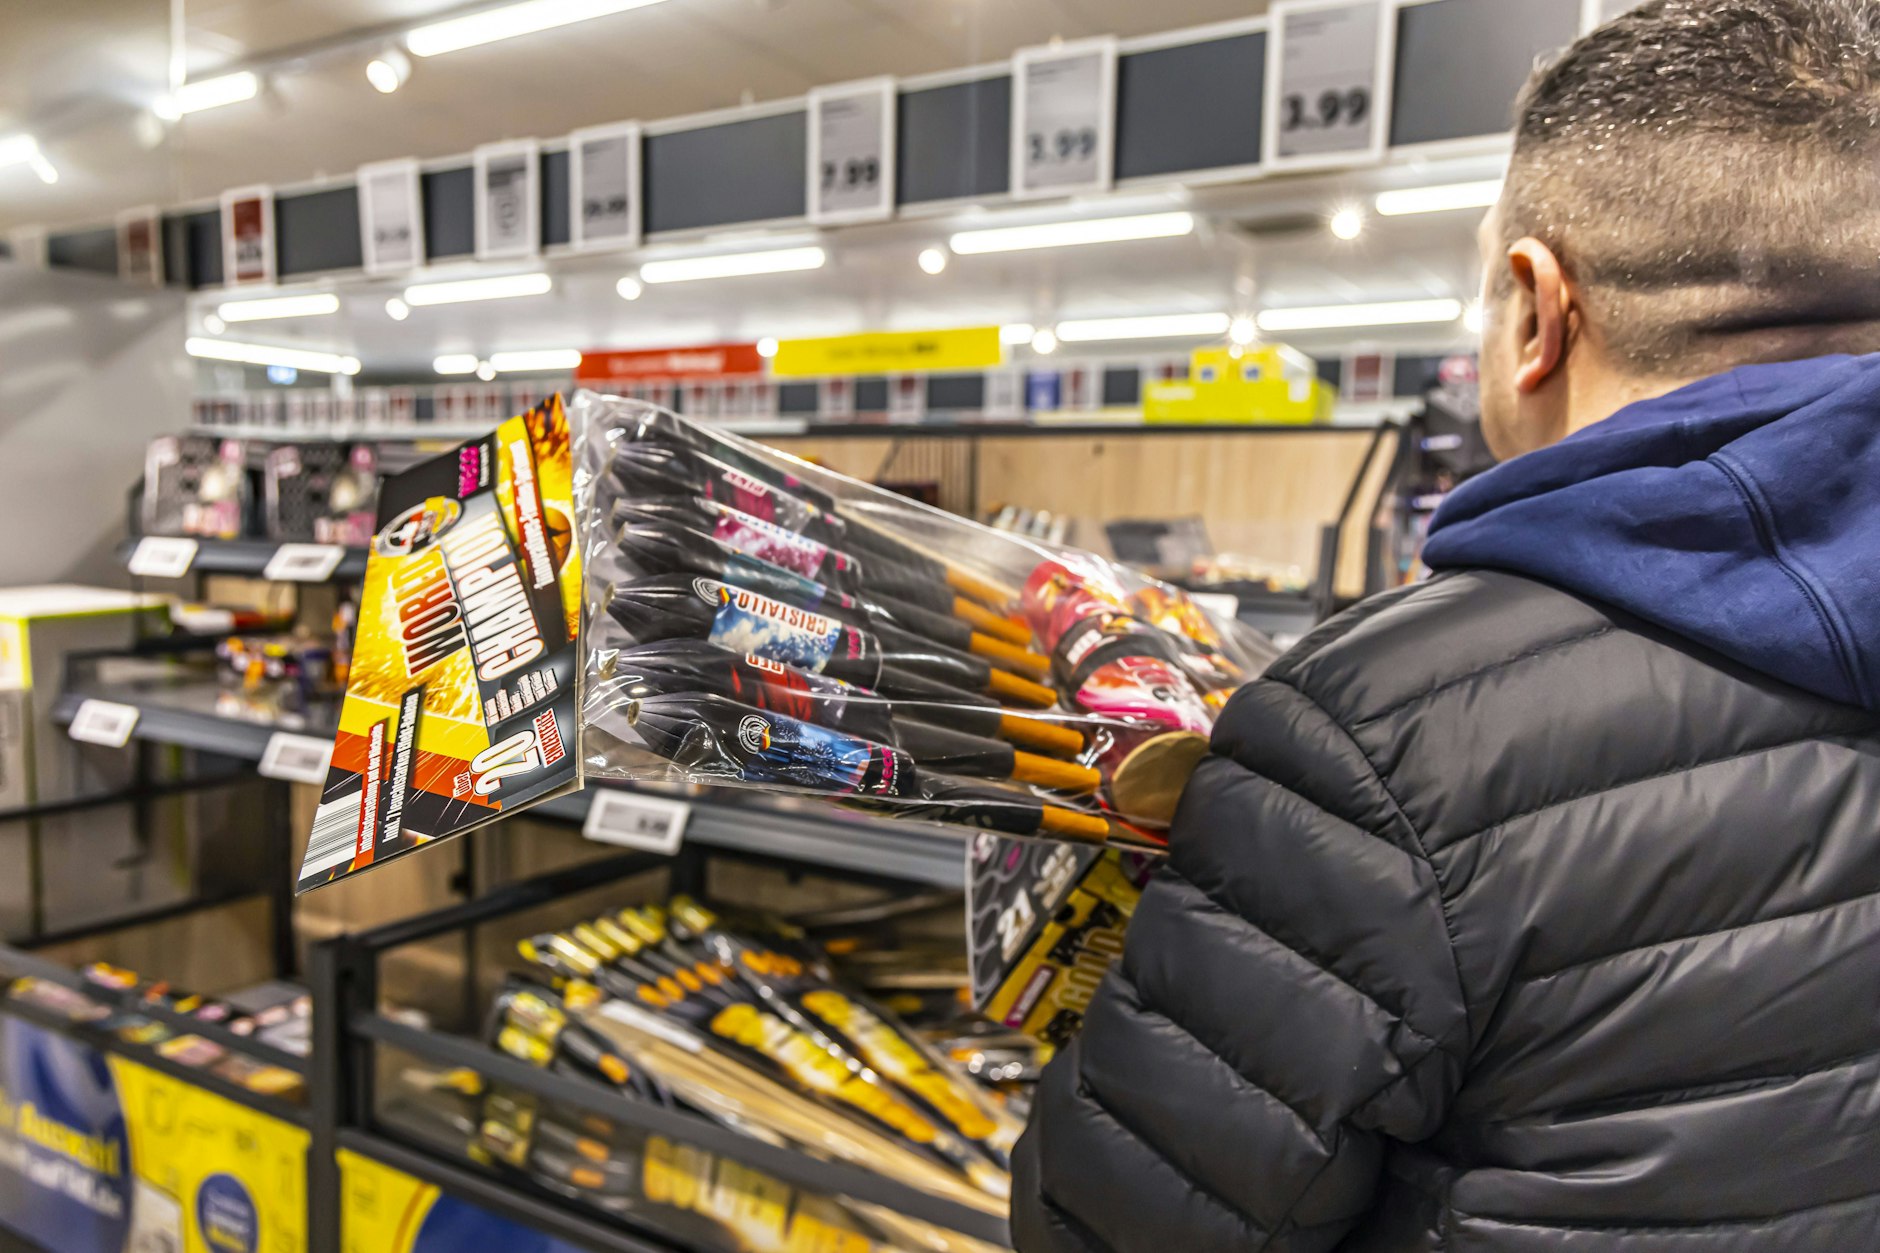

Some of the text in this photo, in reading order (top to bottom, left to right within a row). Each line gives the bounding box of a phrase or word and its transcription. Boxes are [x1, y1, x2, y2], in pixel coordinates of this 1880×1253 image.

[394, 543, 467, 676] WORLD
[448, 510, 543, 682] CHAMPION
[747, 654, 782, 674] RED
[368, 755, 380, 770] der
[382, 692, 418, 843] Inkl. 7 leuchtstarken Effekt-Raketen
[471, 729, 540, 795] 20
[539, 709, 565, 767] EINZELTEILE
[367, 767, 379, 782] auf
[453, 771, 472, 798] über
[359, 779, 379, 853] Inhaltsdarstellung
[997, 888, 1037, 963] 21
